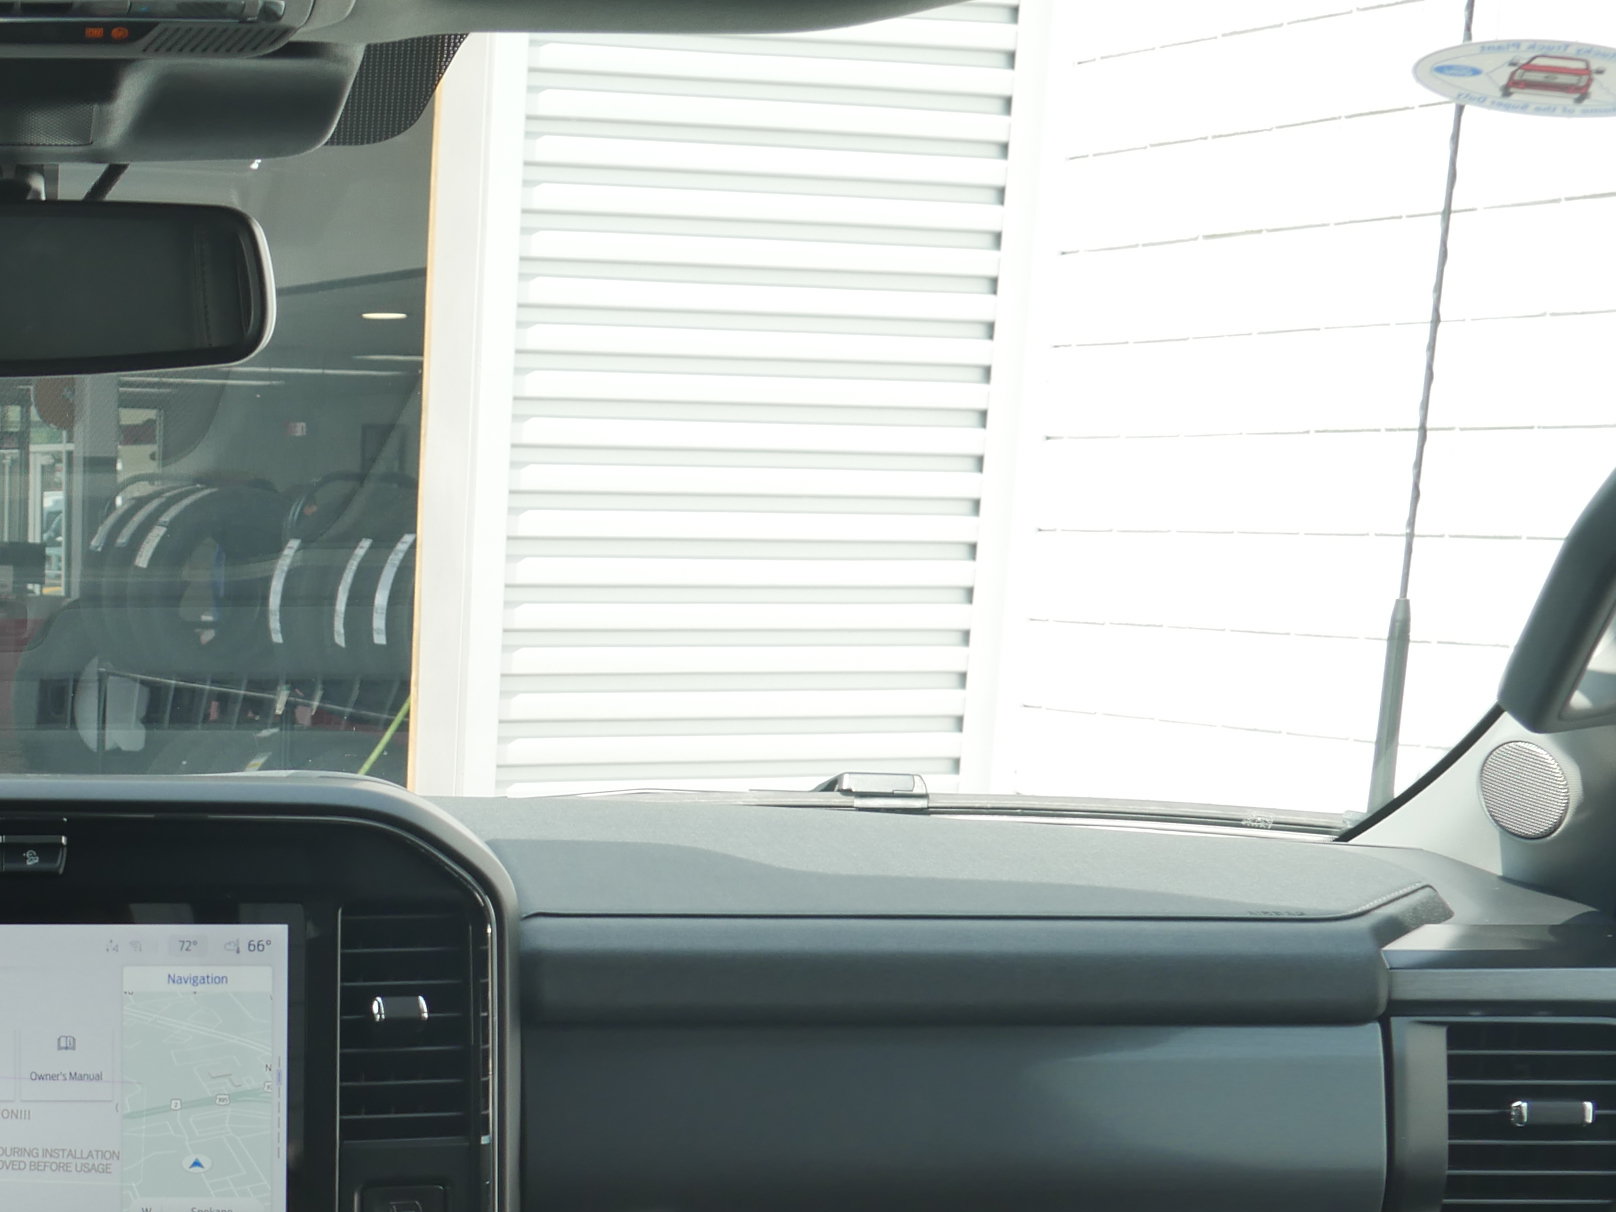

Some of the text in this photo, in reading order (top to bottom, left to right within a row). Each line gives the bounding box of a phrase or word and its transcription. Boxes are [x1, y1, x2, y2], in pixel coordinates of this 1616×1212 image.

[167, 973, 228, 987] Navigation
[30, 1071, 103, 1081] Owner's Manual
[42, 1147, 120, 1160] INSTALLATION
[29, 1160, 72, 1172] BEFORE
[75, 1162, 112, 1174] USAGE
